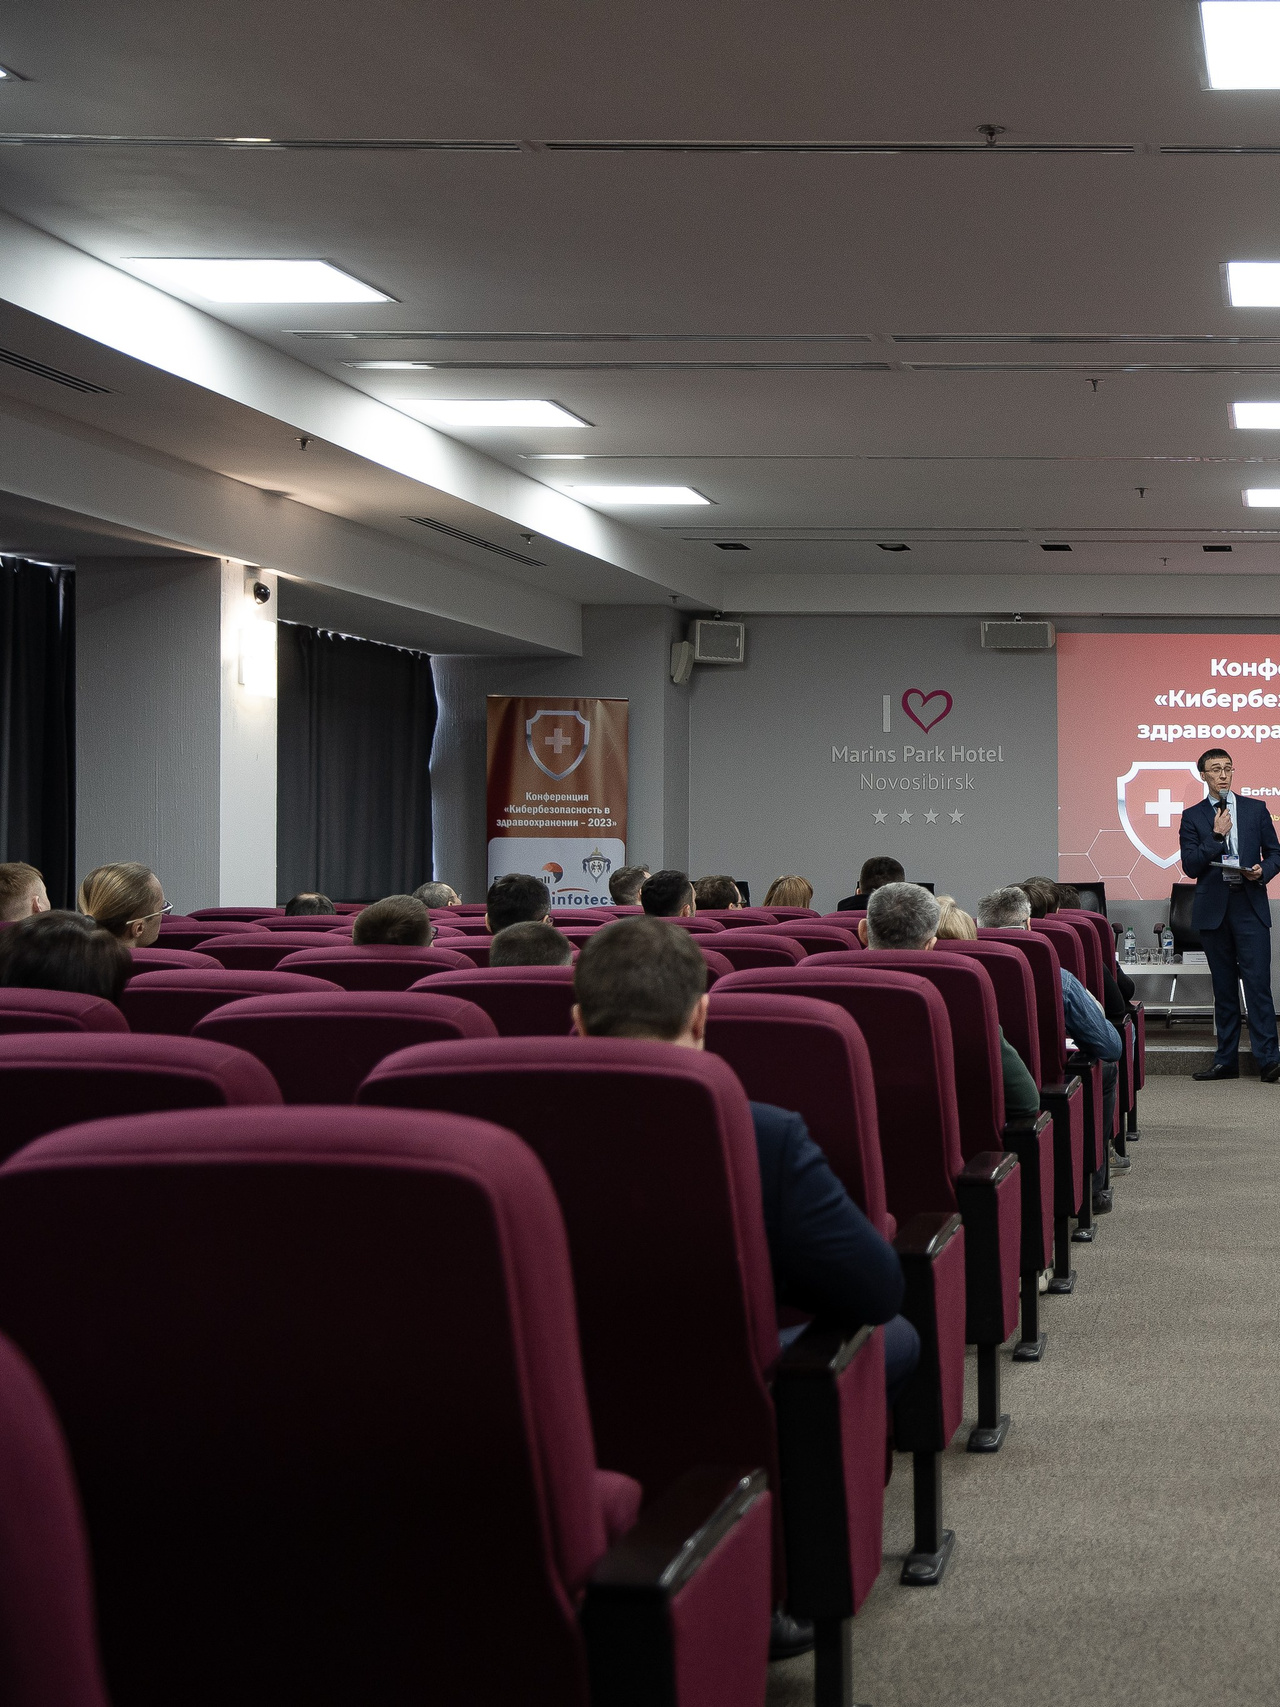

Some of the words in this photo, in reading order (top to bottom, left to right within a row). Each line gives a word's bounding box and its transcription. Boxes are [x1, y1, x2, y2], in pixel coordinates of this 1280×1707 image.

[831, 745, 897, 763] Marins
[903, 745, 946, 763] Park
[951, 745, 1004, 763] Hotel
[860, 773, 975, 790] Novosibirsk
[525, 792, 589, 801] Конференция
[504, 805, 602, 815] «Кибербезопасность
[496, 819, 578, 829] здравоохранении
[588, 818, 617, 827] 2023»
